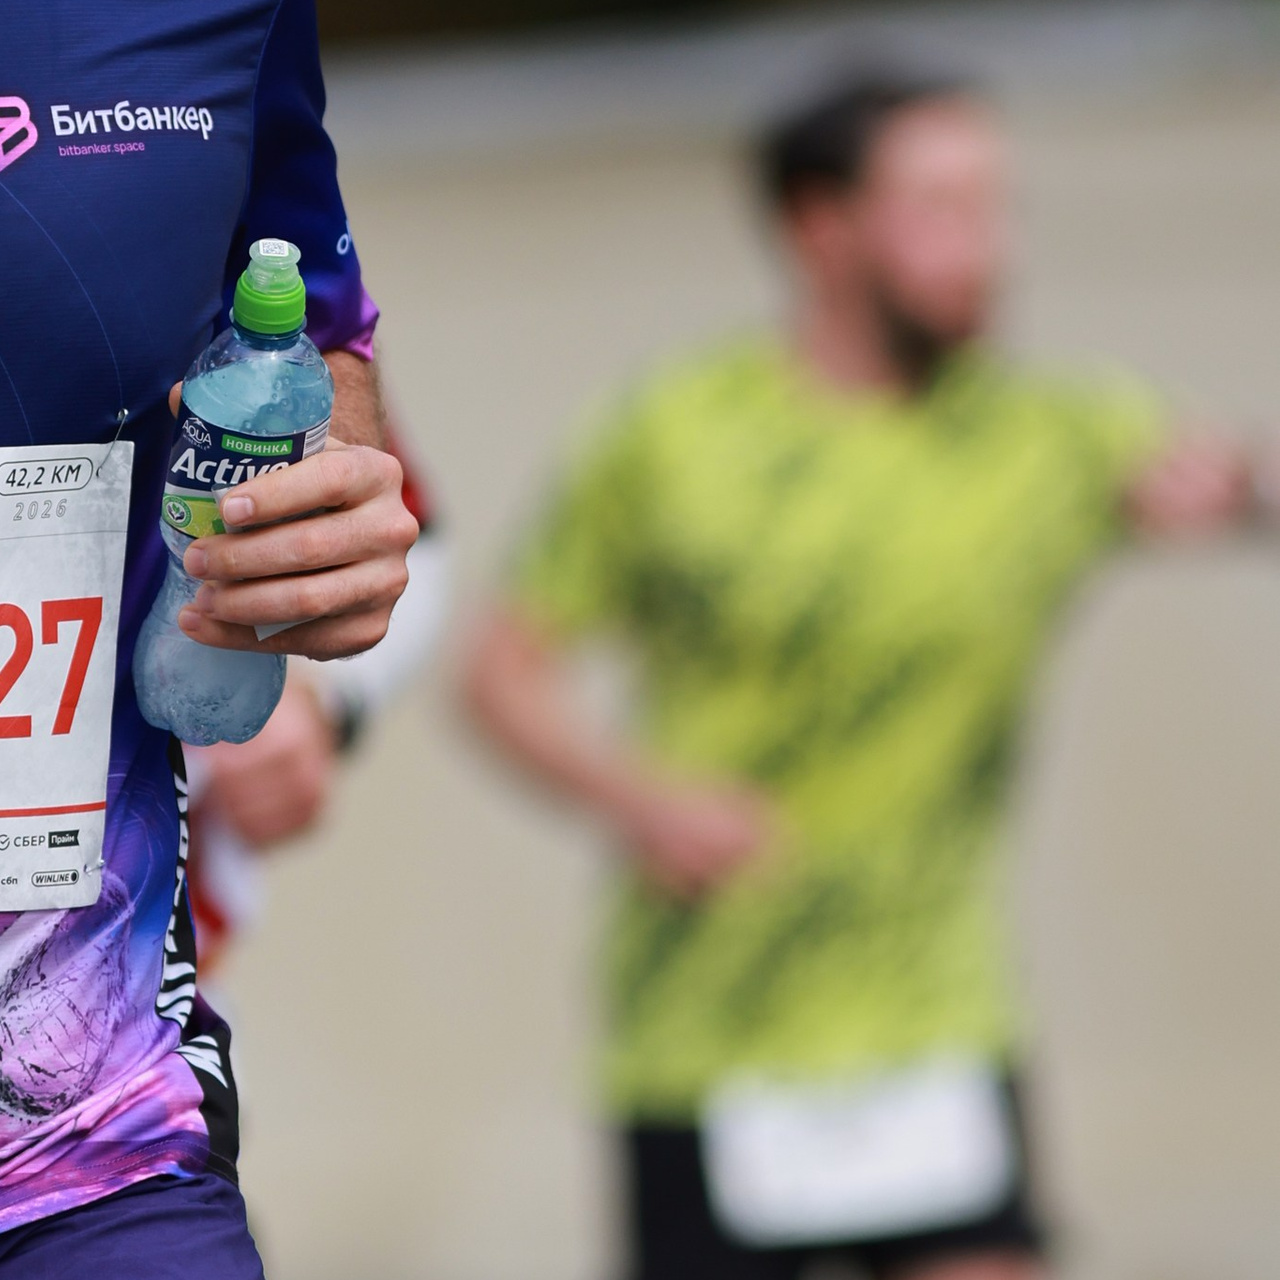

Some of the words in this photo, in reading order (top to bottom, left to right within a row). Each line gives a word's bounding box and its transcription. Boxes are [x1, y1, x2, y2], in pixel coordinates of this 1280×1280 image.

[50, 100, 214, 140] Битбанкер
[58, 141, 146, 157] bitbanker.space
[182, 419, 212, 446] AQUA
[226, 438, 289, 454] НОВИНКА
[6, 467, 45, 489] 42,2
[50, 464, 82, 484] КМ
[13, 498, 67, 521] 2026
[13, 835, 45, 847] СБЕР
[51, 832, 75, 844] Прайм
[1, 876, 18, 885] сбп
[35, 872, 70, 884] WINLINE
